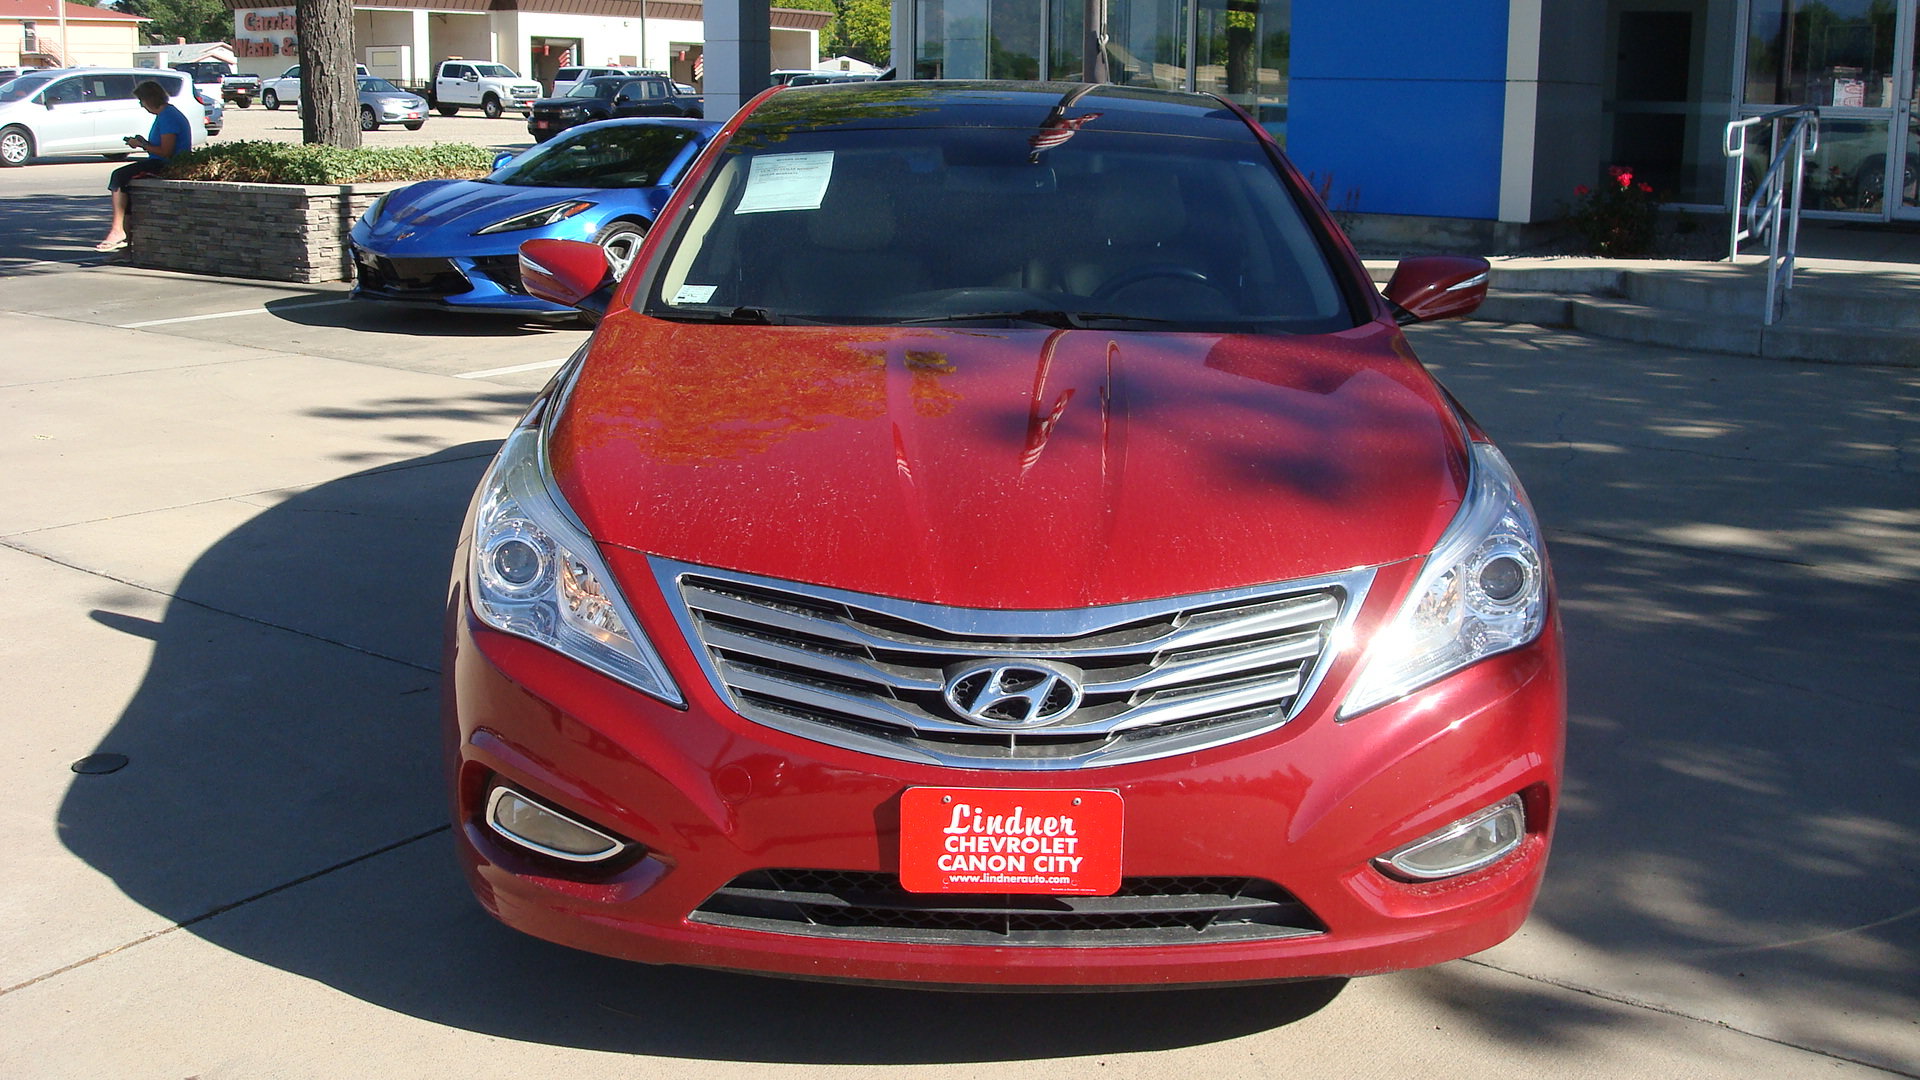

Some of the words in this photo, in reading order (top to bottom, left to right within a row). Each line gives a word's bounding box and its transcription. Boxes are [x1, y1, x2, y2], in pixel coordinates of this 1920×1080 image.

[229, 38, 274, 57] Wash
[943, 803, 1076, 837] Lindner
[944, 836, 1078, 854] CHEVROLET
[937, 855, 1026, 872] CANON
[1033, 856, 1084, 873] CITY
[949, 872, 1070, 884] www.lindnerauto.com
